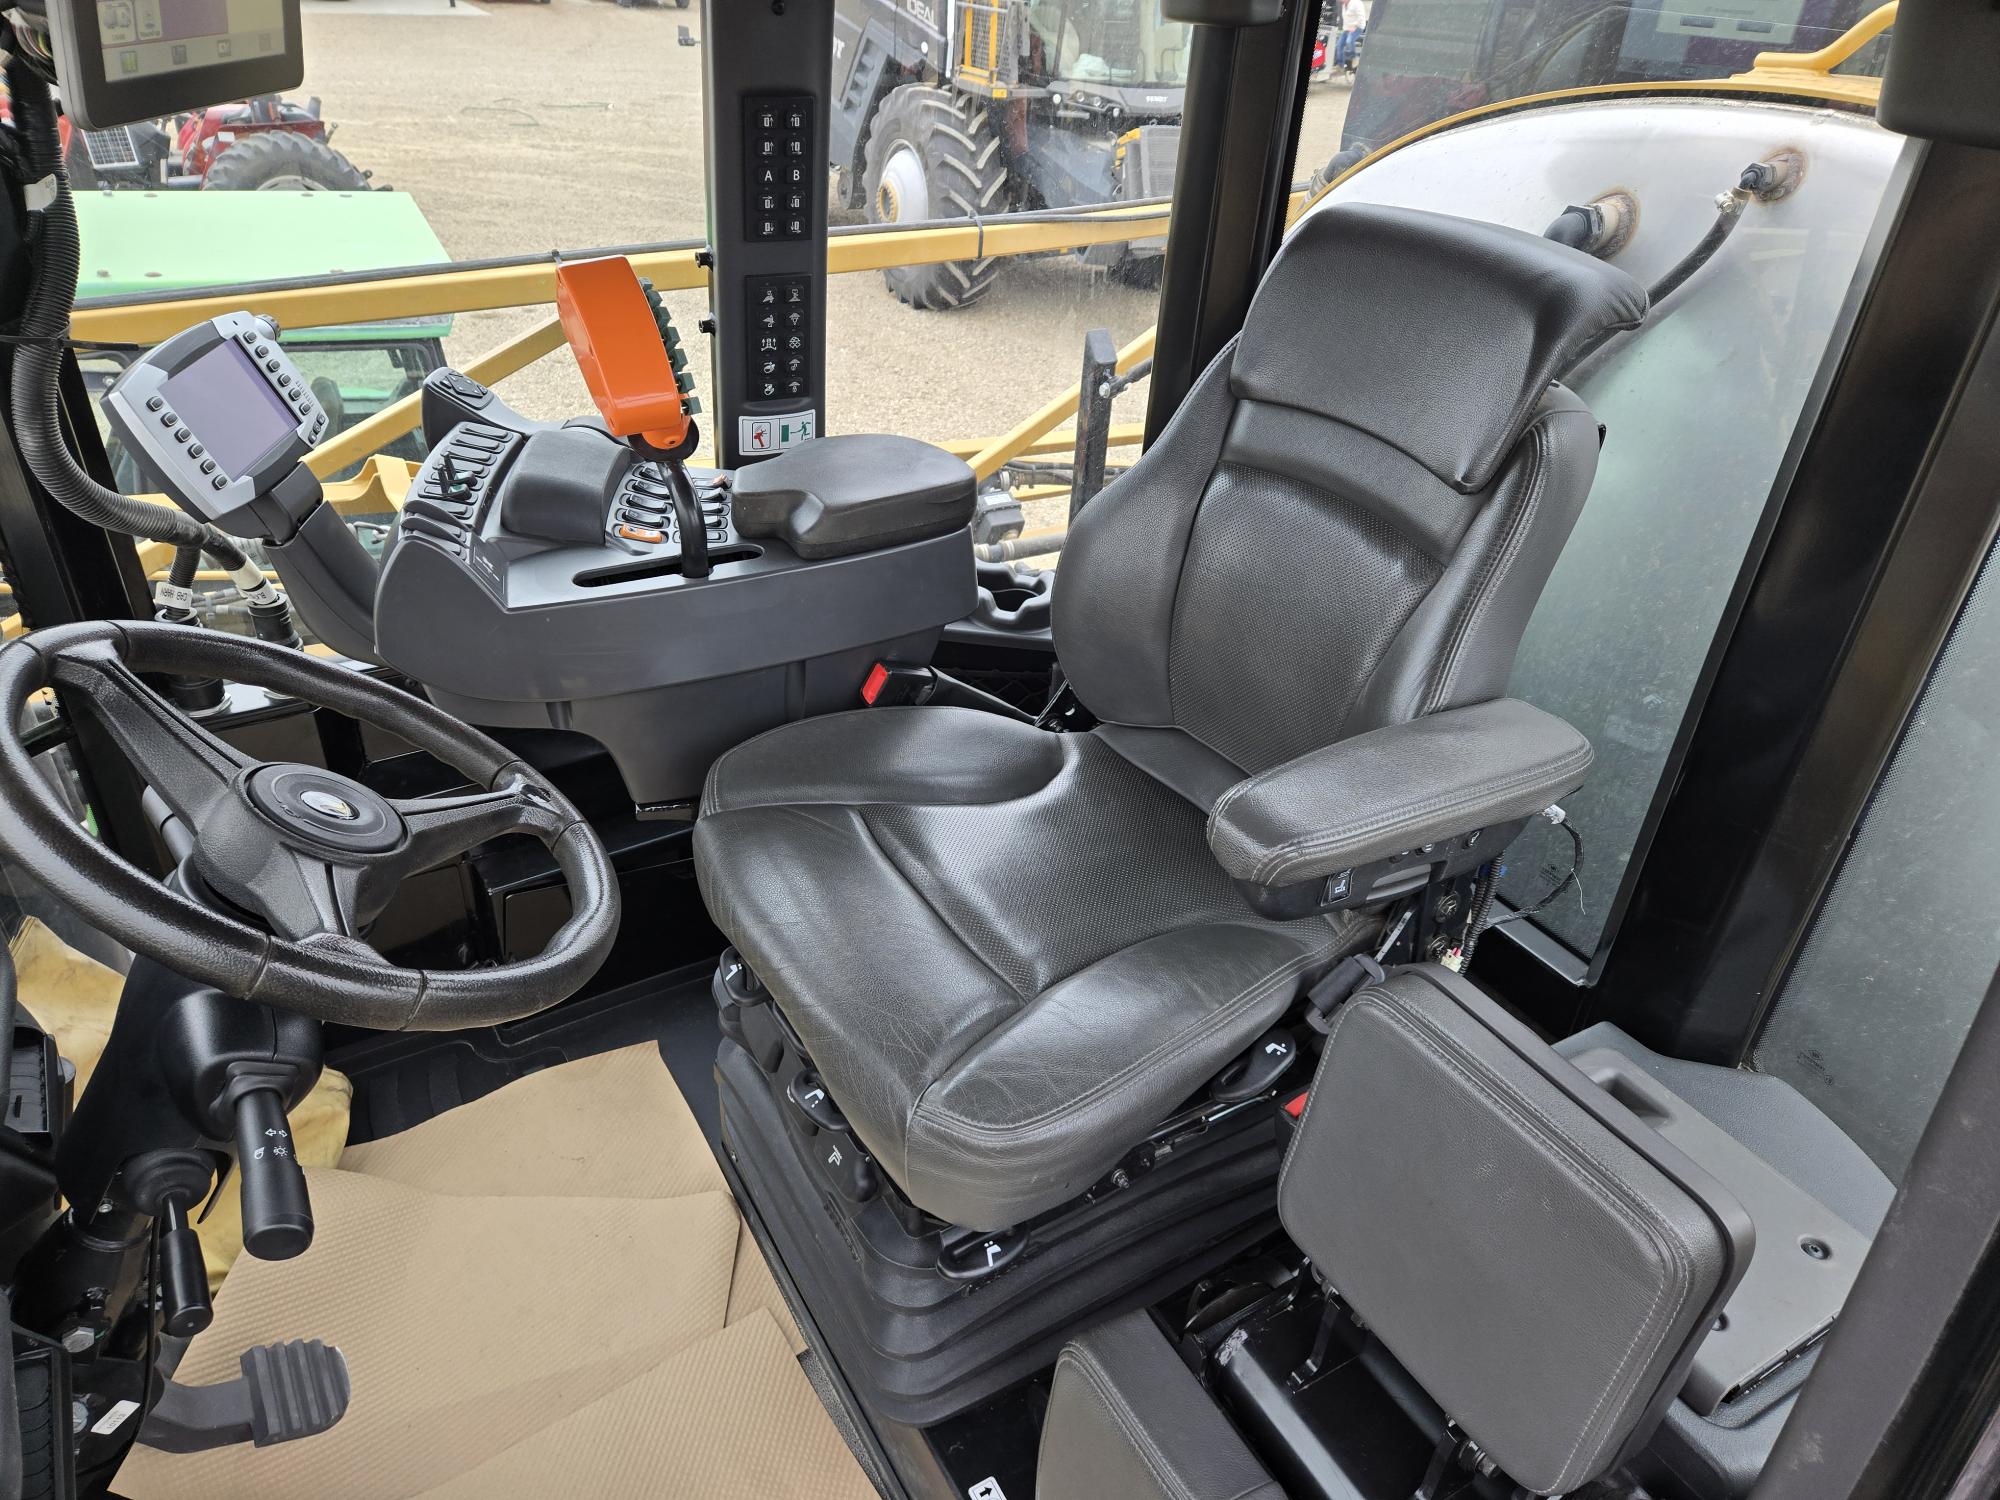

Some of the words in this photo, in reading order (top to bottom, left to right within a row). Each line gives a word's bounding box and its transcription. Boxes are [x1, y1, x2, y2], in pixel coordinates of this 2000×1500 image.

[907, 0, 938, 29] IDEAL
[765, 170, 773, 182] A
[793, 169, 800, 181] B
[176, 591, 188, 602] CAB
